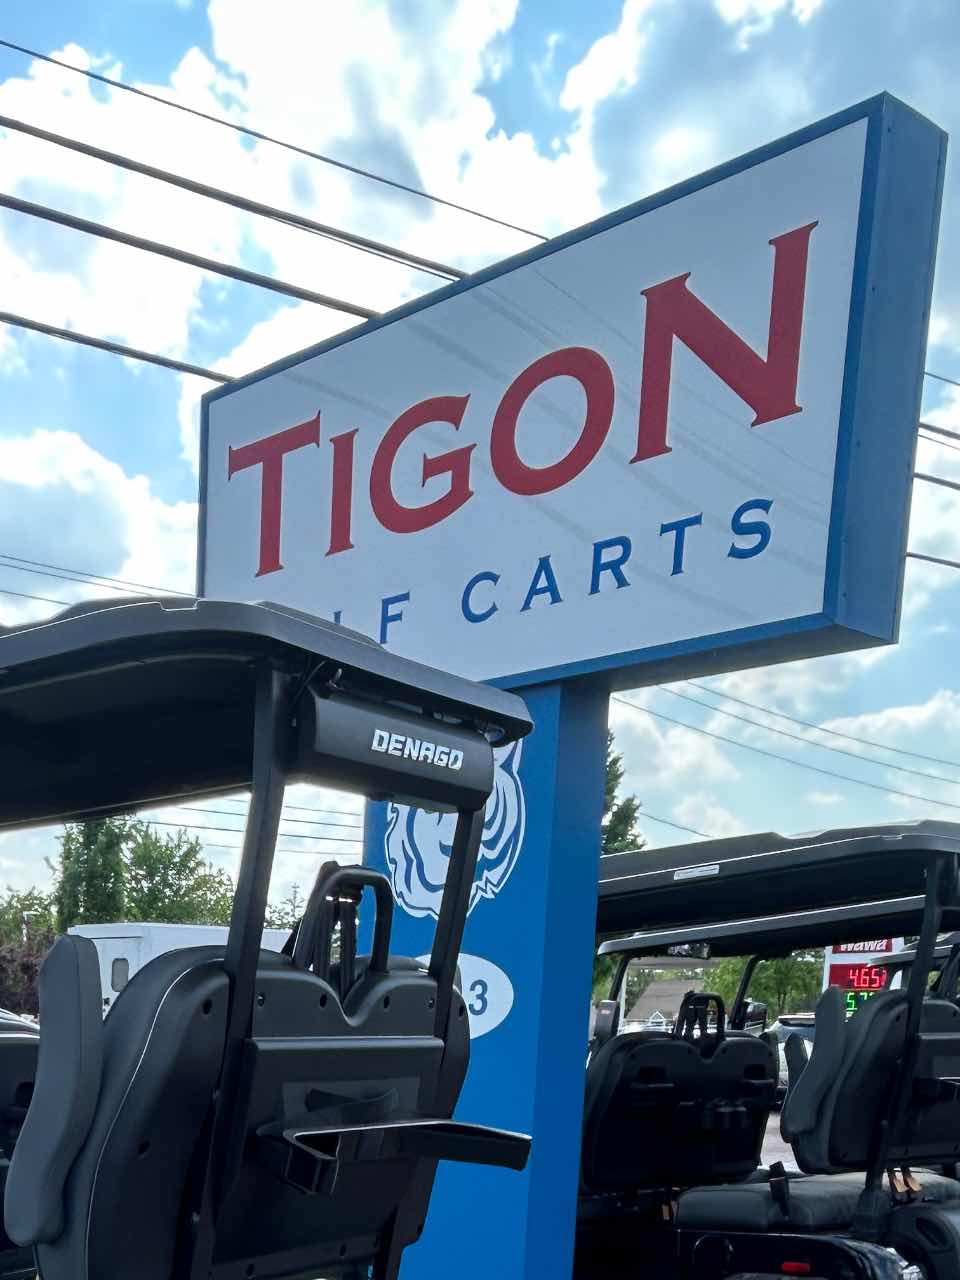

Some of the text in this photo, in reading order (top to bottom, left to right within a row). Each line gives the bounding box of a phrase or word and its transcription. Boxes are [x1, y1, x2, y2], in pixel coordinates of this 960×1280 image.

[228, 220, 819, 578] TIGON
[461, 498, 774, 623] CARTS
[371, 729, 464, 770] DENAGO
